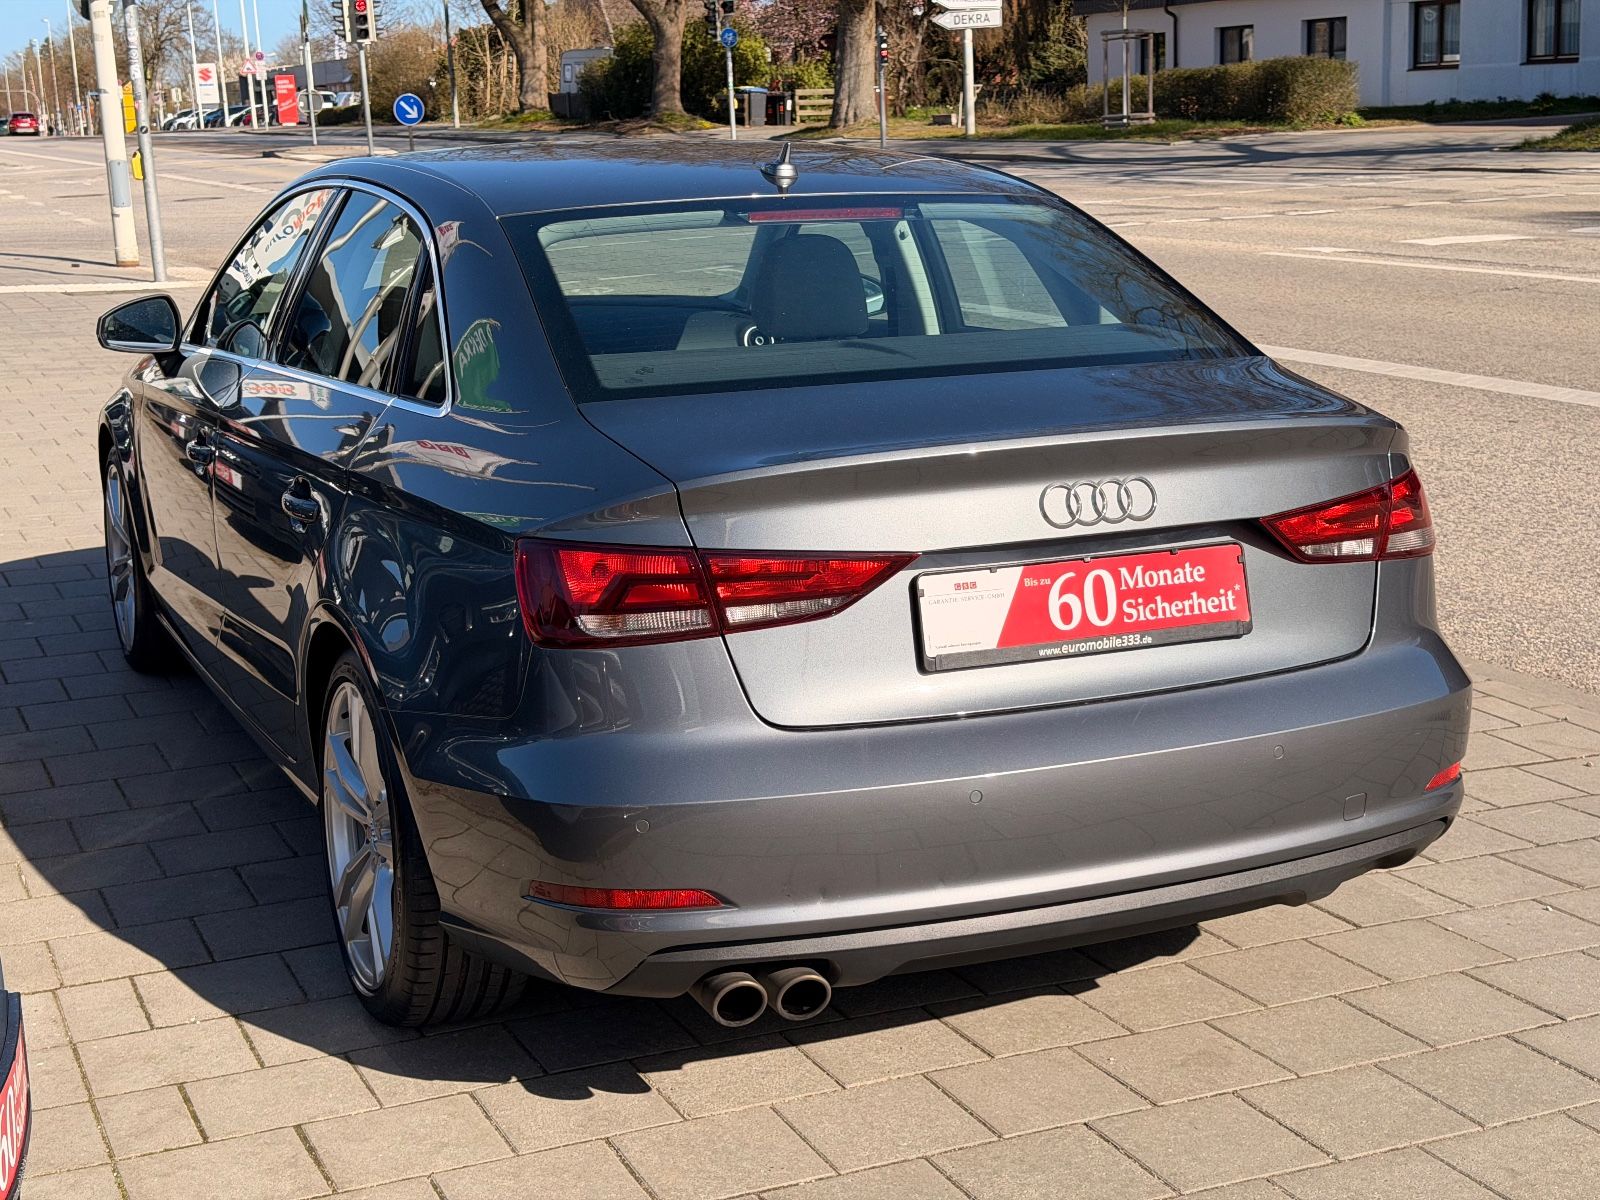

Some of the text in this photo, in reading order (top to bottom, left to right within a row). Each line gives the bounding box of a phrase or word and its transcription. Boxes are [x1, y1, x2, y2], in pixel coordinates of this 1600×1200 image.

[953, 13, 990, 25] DEKRA
[1024, 577, 1051, 587] Bis zu
[1118, 562, 1206, 590] Monate
[1048, 569, 1117, 631] 60
[1038, 634, 1153, 656] www.euromobile333.de
